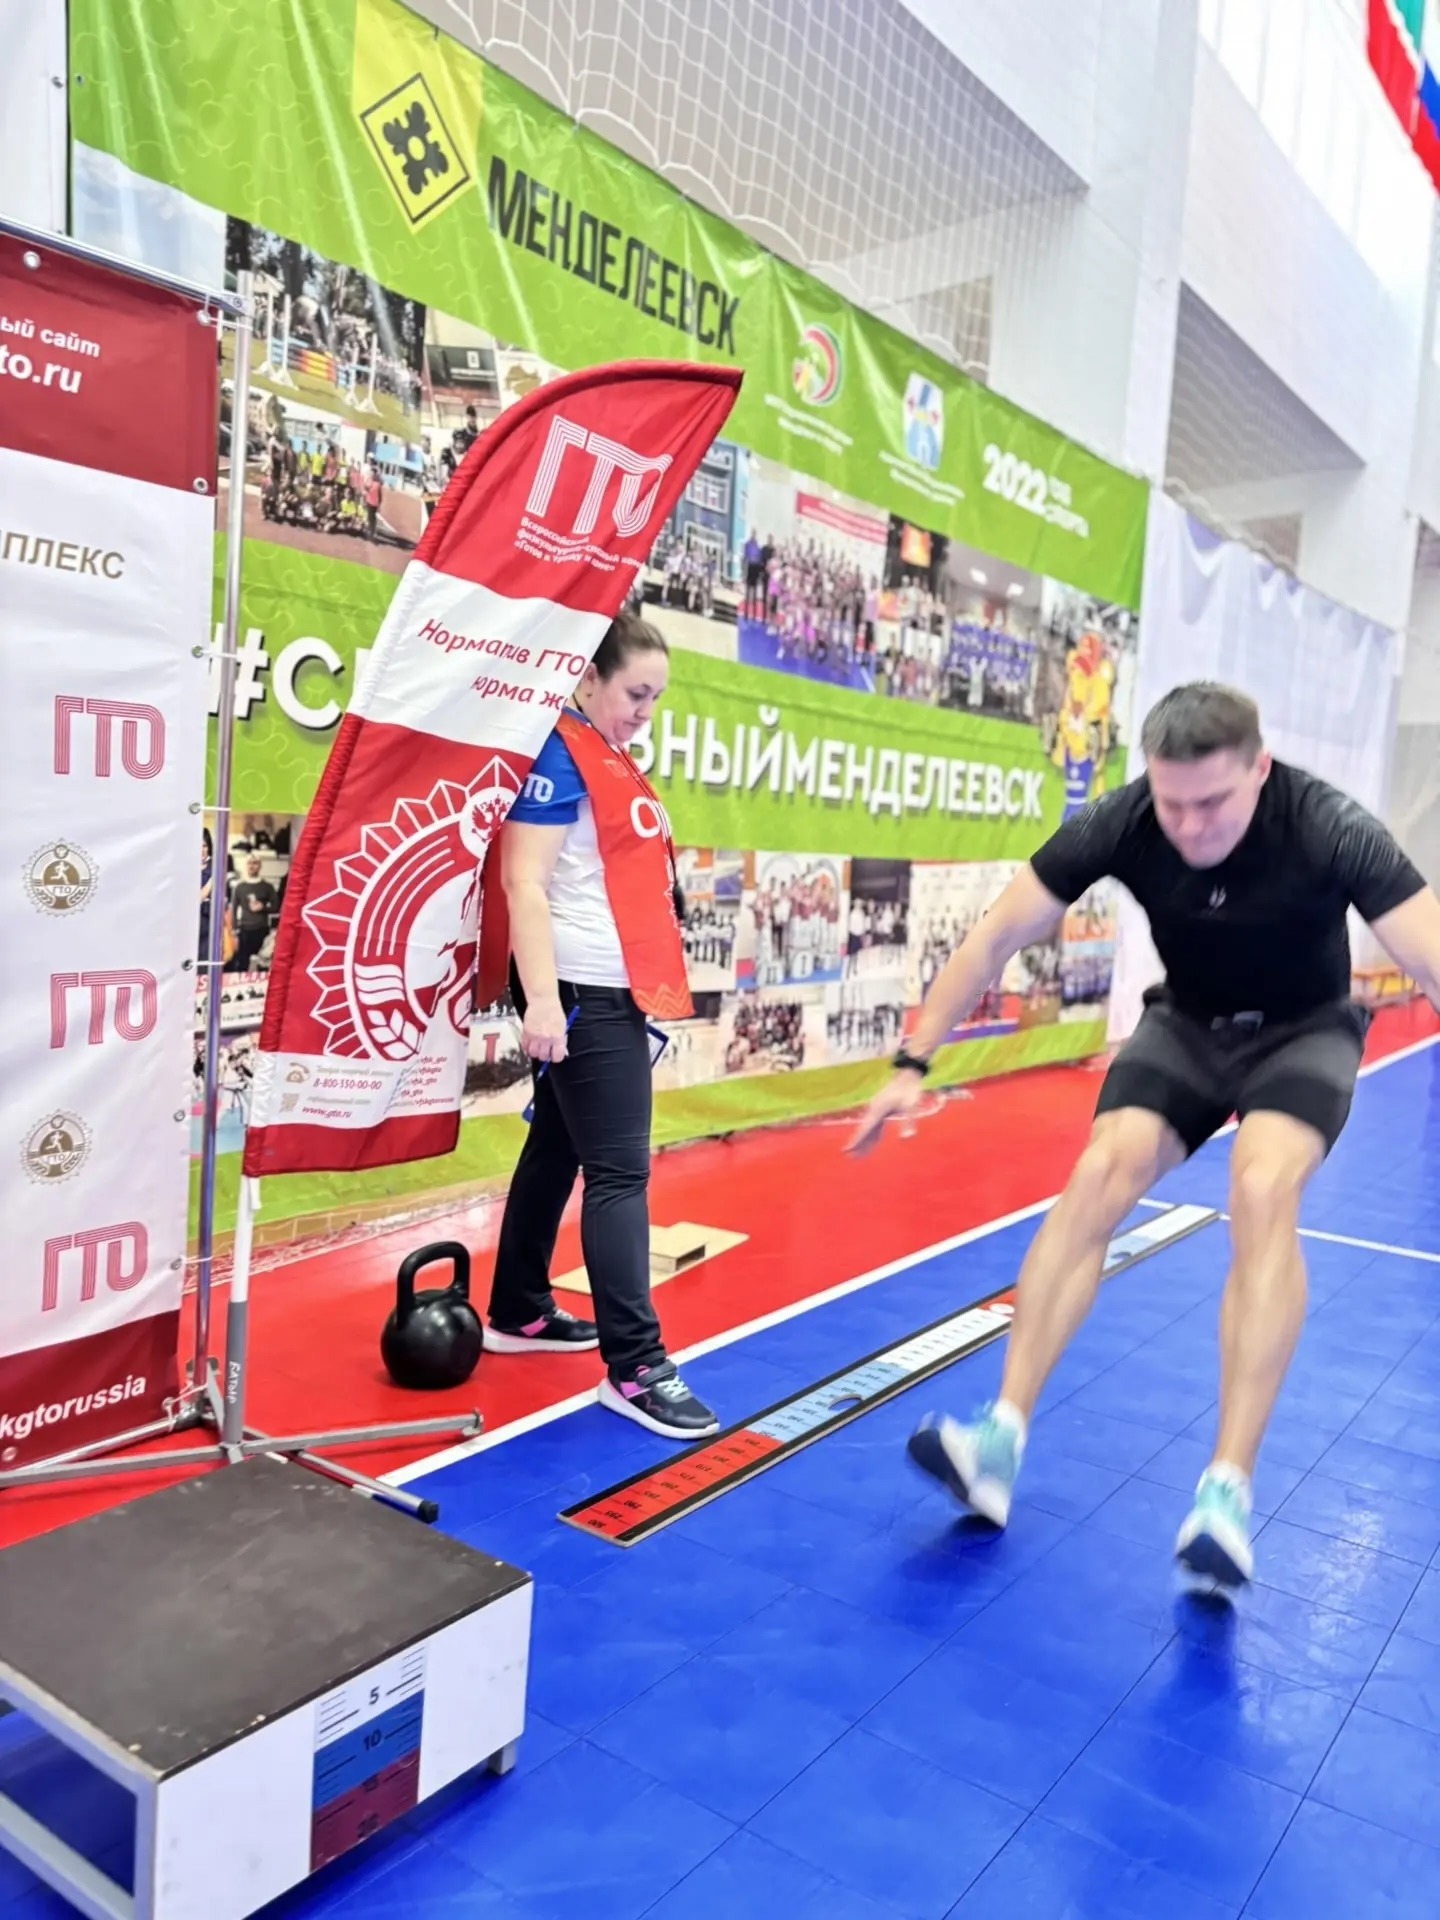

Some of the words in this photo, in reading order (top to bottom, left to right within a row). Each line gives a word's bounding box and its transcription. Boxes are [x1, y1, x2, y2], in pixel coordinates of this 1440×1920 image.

[488, 155, 740, 356] МЕНДЕЛЕЕВСК
[40, 328, 100, 358] сайт
[525, 414, 673, 537] ГТО
[982, 443, 1048, 516] 2022
[0, 530, 125, 579] ПЛЕКС
[535, 649, 586, 676] ГТО
[54, 695, 165, 779] ГТО
[523, 773, 554, 802] ТО
[50, 969, 157, 1049] ГТО
[302, 1106, 352, 1119] www.gto.ru
[42, 1221, 148, 1312] ГТО
[0, 1375, 146, 1440] kgtorussia
[368, 1686, 380, 1706] 5
[363, 1727, 383, 1751] 10
